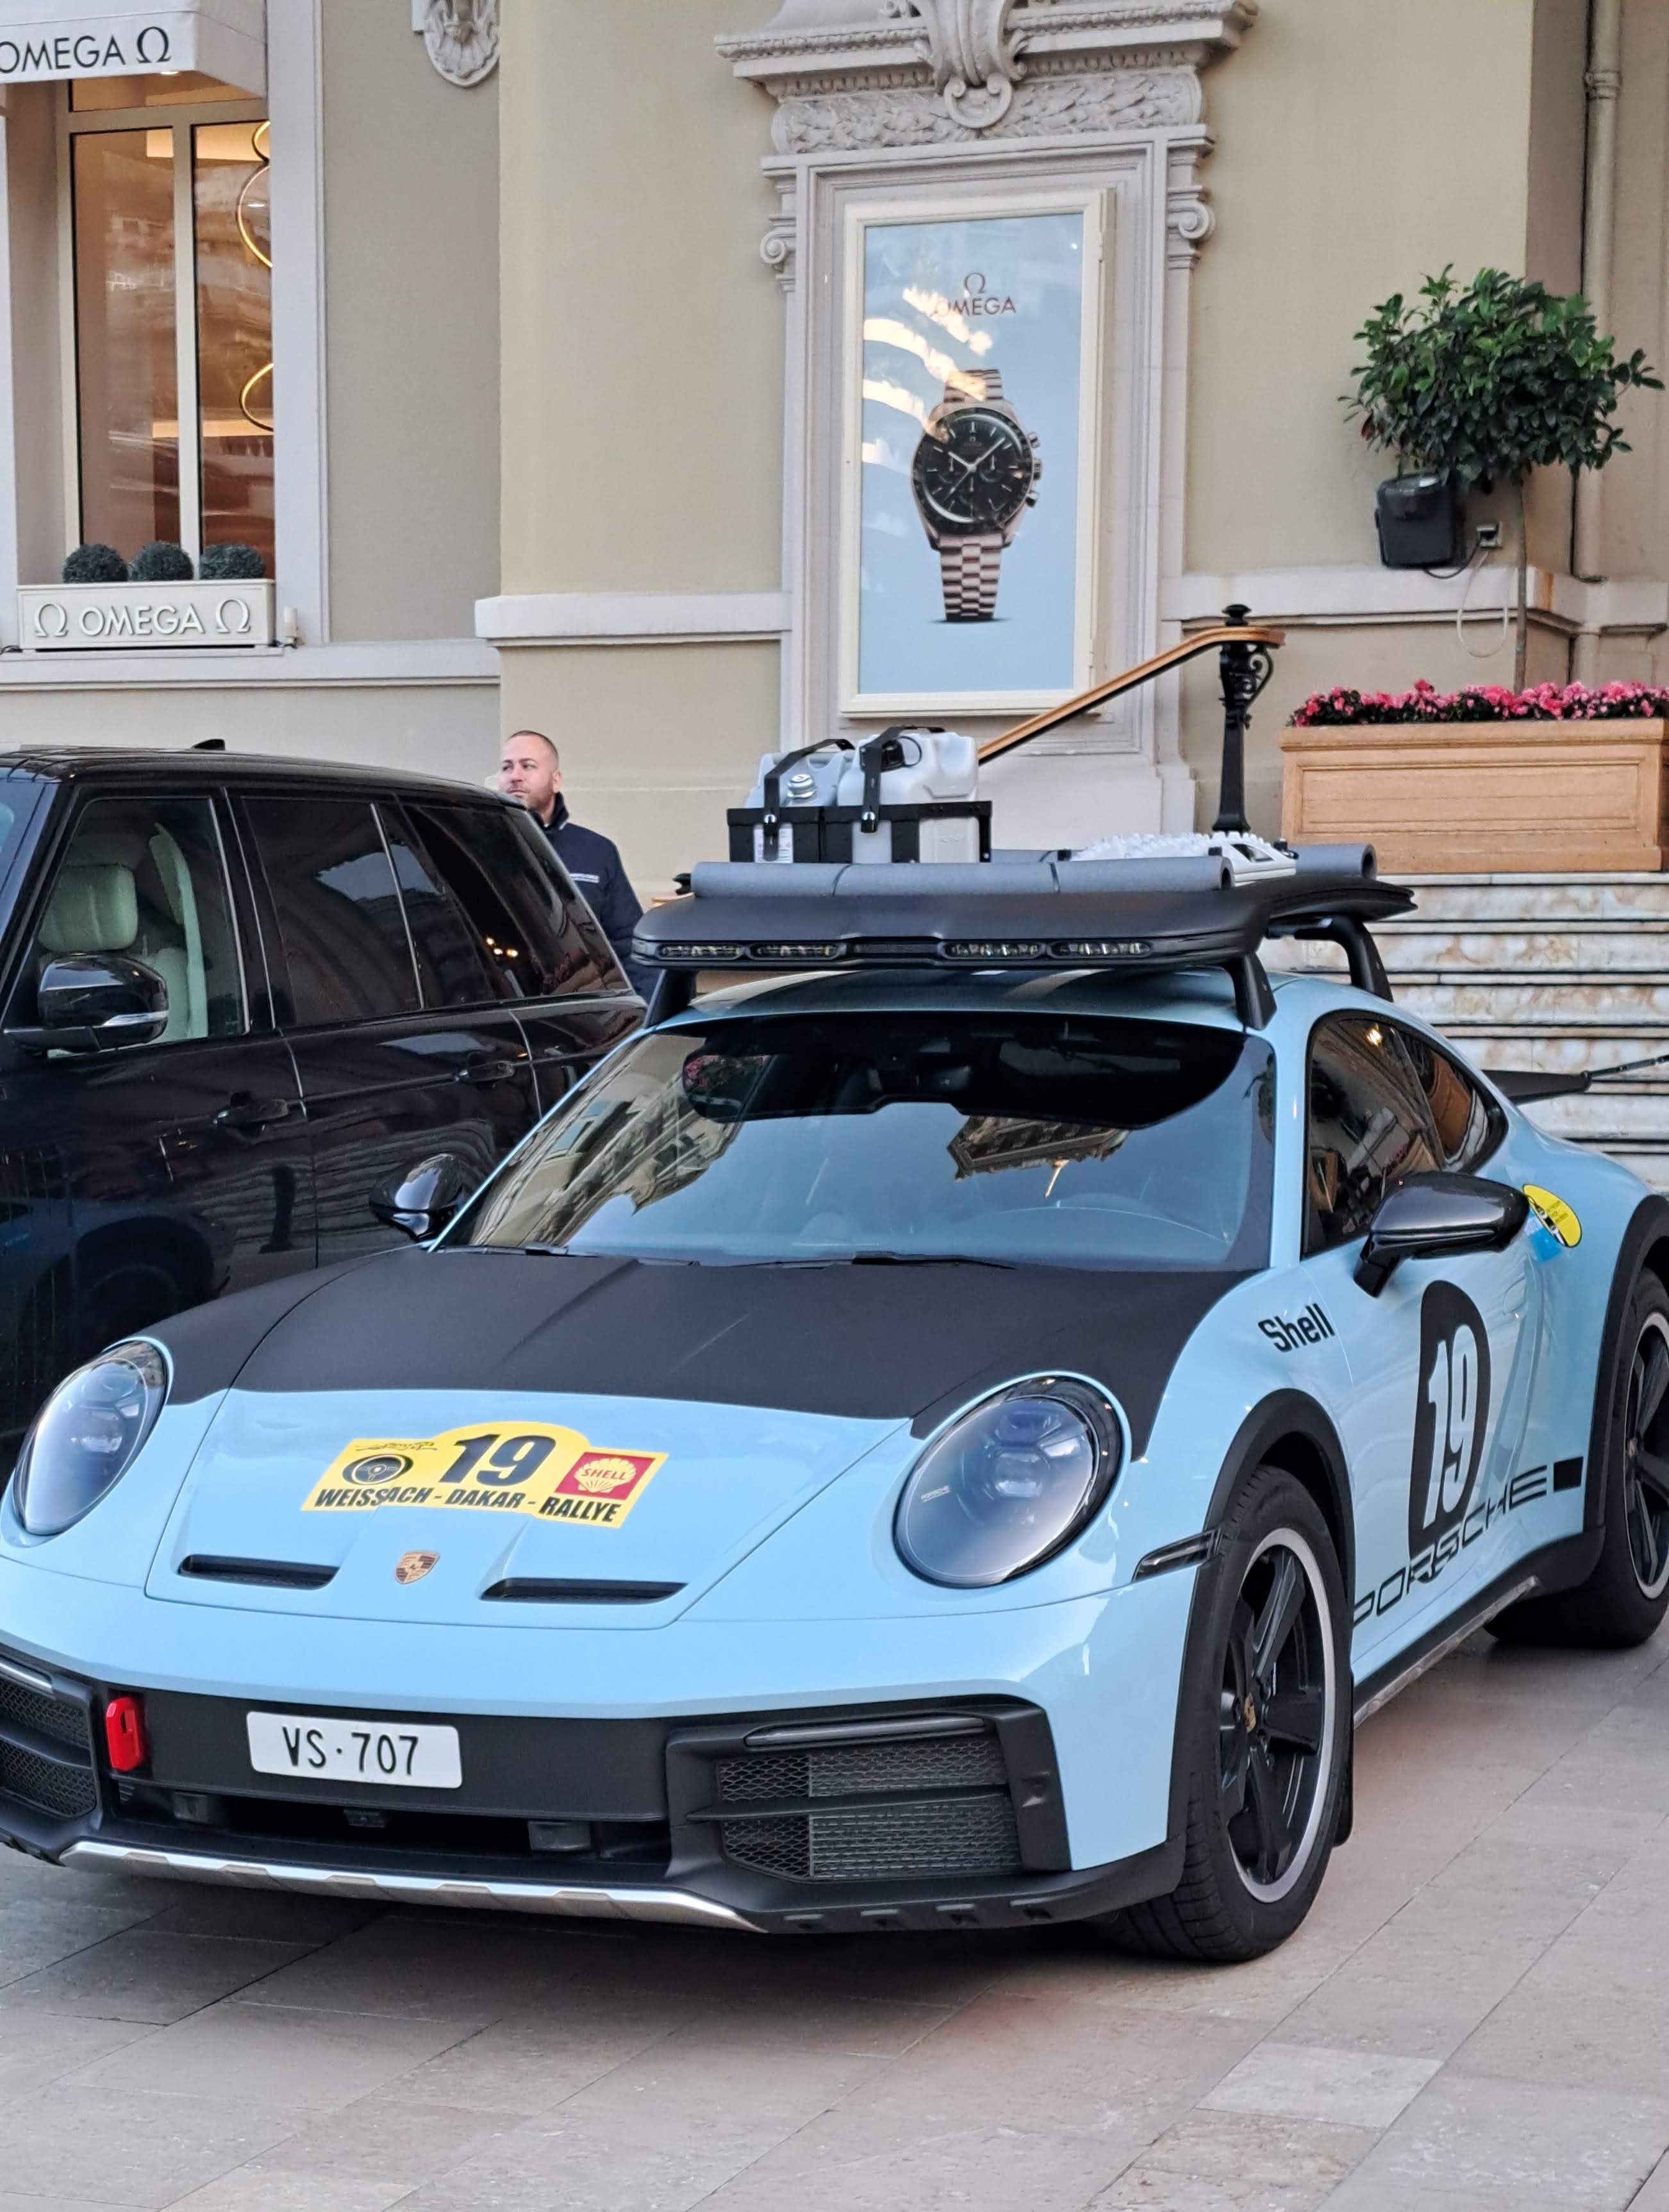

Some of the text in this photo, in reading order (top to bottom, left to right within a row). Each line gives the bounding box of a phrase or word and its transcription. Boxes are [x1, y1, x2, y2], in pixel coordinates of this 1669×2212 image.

[0, 35, 126, 74] OMEGA
[936, 296, 1017, 317] OMEGA
[79, 604, 204, 636] OMEGA
[1258, 1303, 1335, 1352] Shell
[1422, 1324, 1478, 1530] 19
[439, 1434, 556, 1486] 19
[581, 1468, 626, 1480] SHELL
[315, 1486, 435, 1507] WEISSACH
[444, 1490, 526, 1508] DAKAR
[538, 1497, 622, 1522] RALLYE
